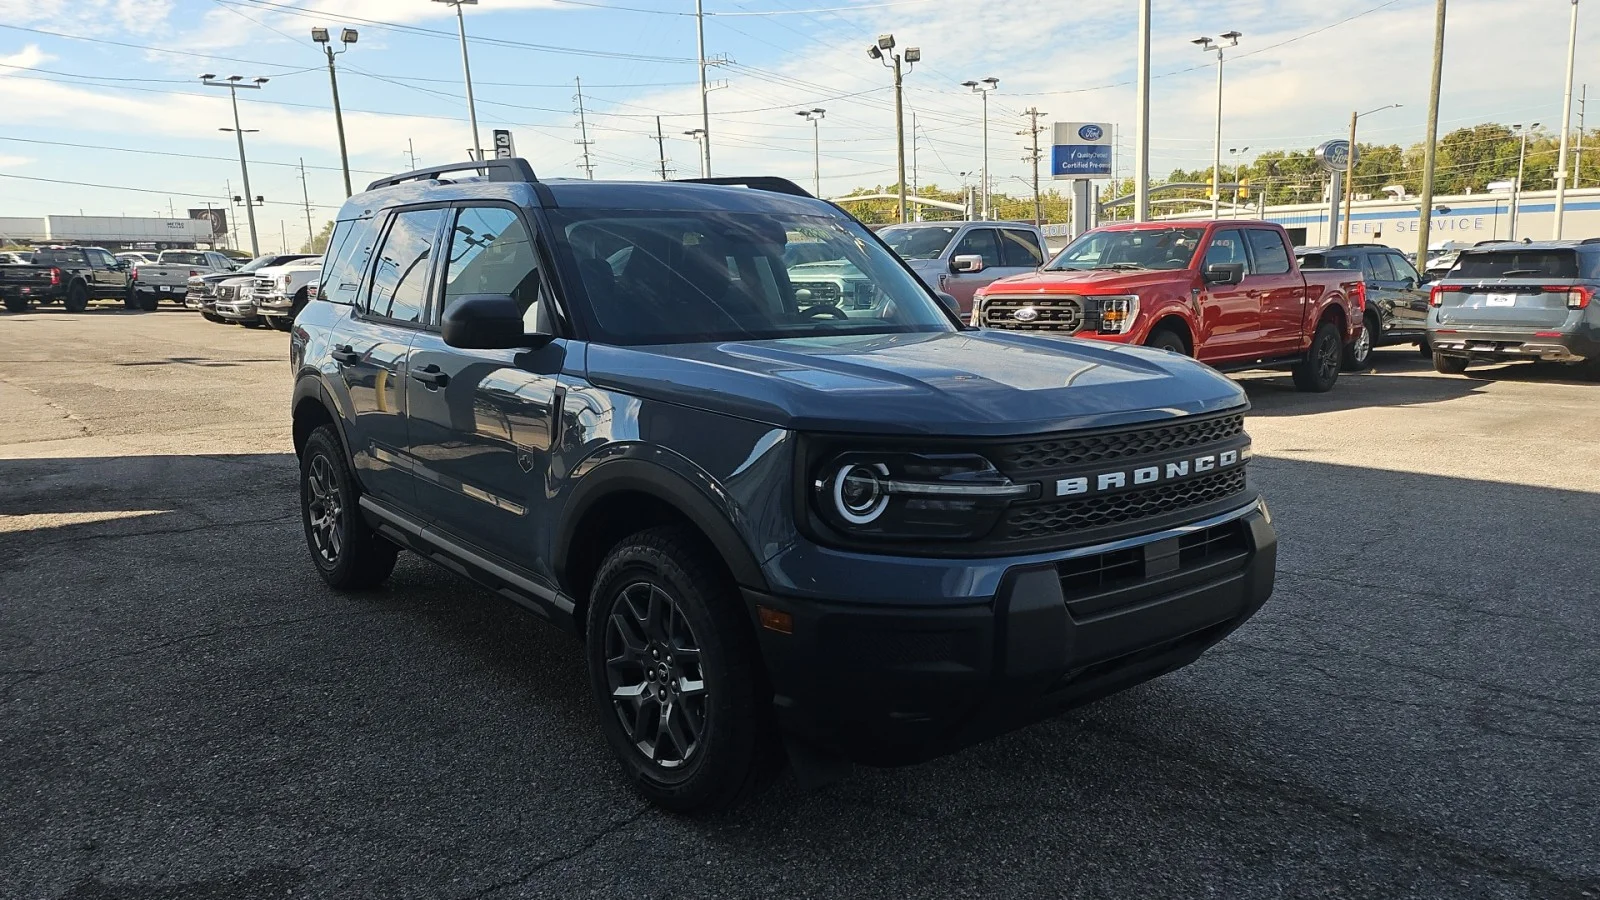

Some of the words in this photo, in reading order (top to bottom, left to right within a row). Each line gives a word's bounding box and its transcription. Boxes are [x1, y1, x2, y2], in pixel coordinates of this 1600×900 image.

[1062, 161, 1088, 169] Certified
[1339, 221, 1384, 235] LEET
[1056, 450, 1237, 496] BRONCO
